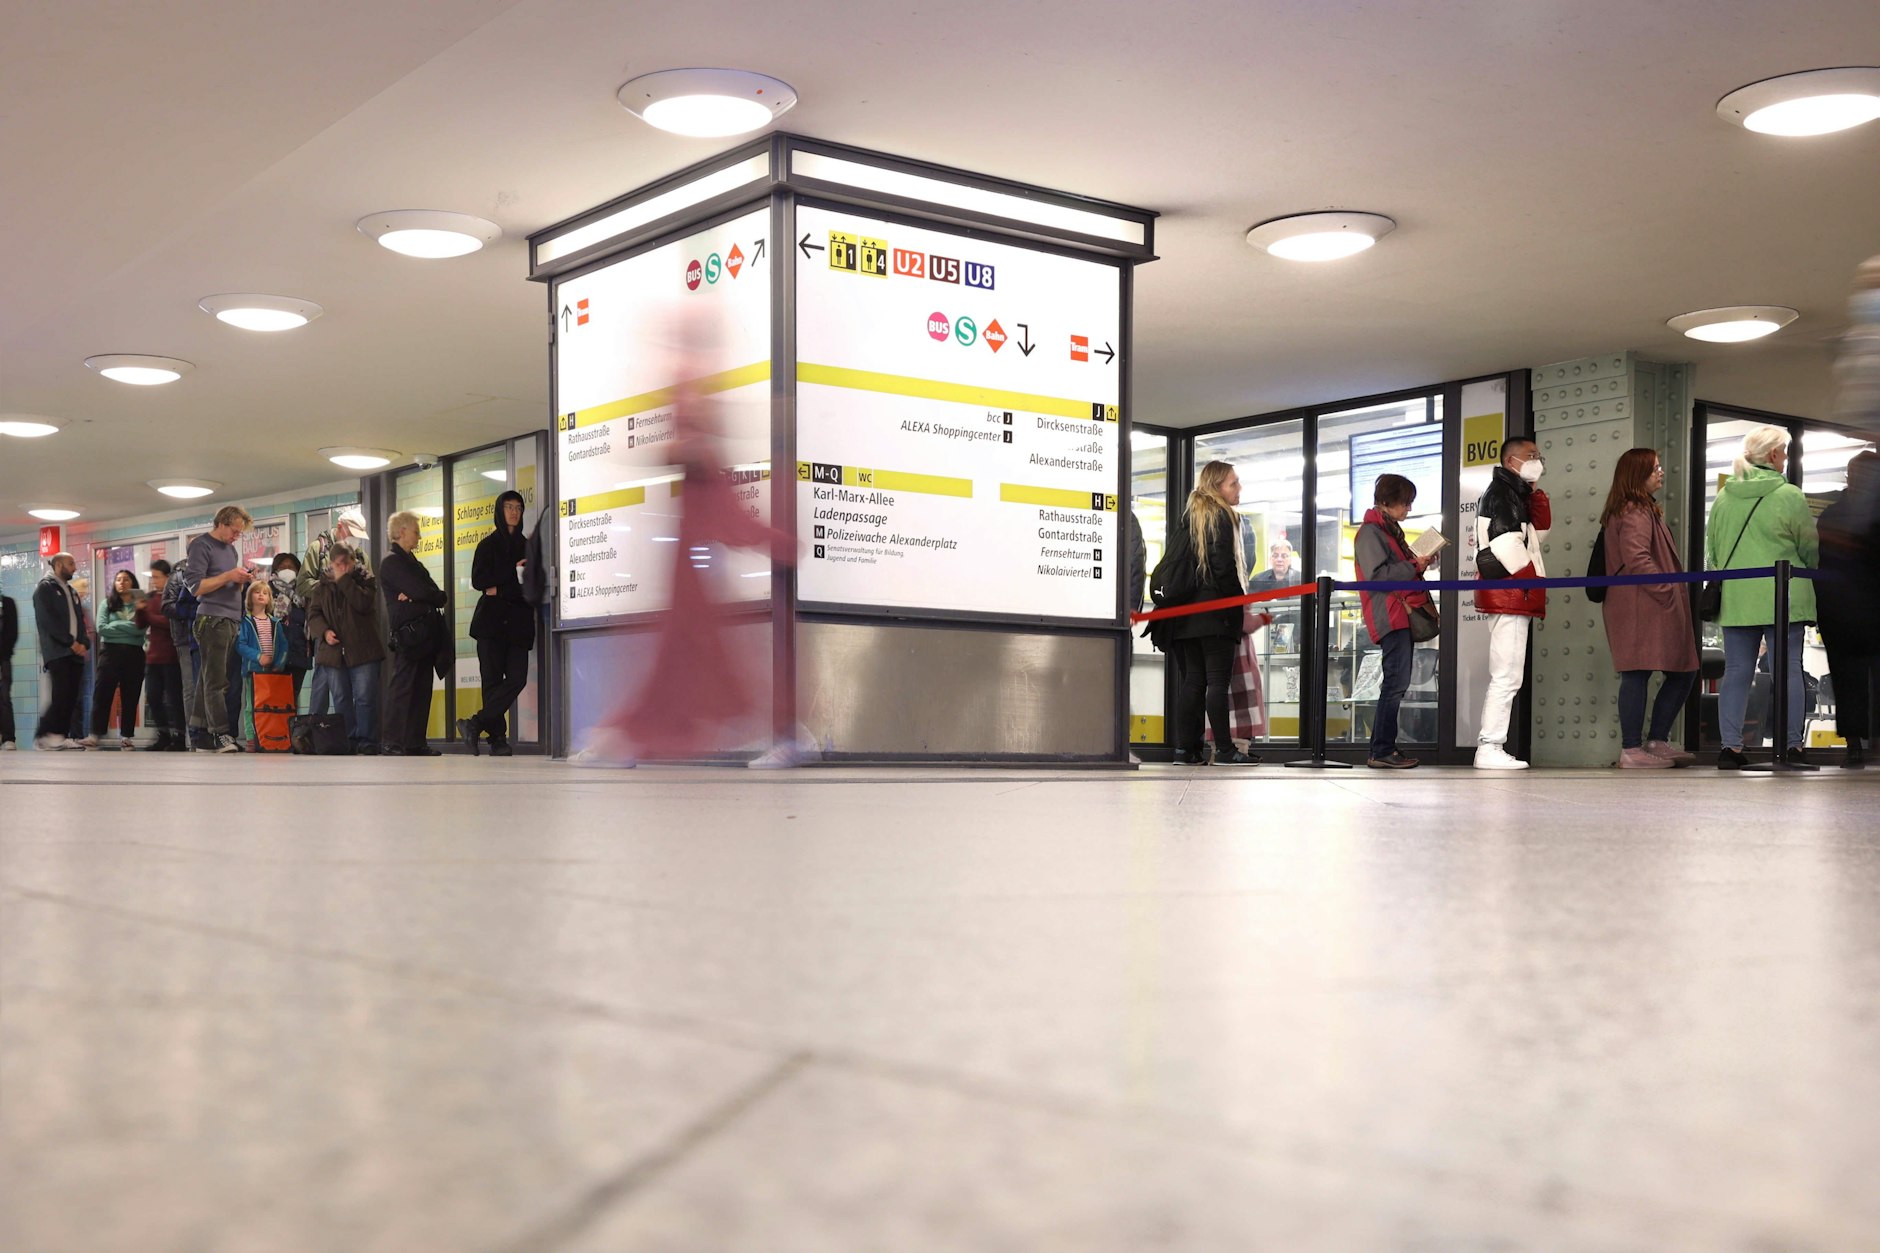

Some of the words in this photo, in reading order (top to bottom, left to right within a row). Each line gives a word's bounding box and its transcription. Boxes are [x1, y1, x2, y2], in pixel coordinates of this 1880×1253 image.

[687, 267, 701, 284] BUS
[707, 253, 720, 283] S
[847, 249, 854, 265] 1
[877, 255, 886, 270] 4
[896, 251, 923, 275] U2
[932, 257, 959, 281] U5
[967, 263, 993, 288] U8
[928, 320, 949, 335] BUS
[957, 317, 975, 345] S
[985, 329, 1005, 342] Bahn
[1070, 341, 1089, 353] Tram
[635, 411, 673, 429] Fernsehturm
[986, 410, 1002, 424] bcc
[568, 424, 610, 445] Rathausstraße
[900, 419, 931, 434] ALEXA
[932, 423, 1002, 442] Shoppingcenter
[1036, 417, 1104, 437] Dircksenstraße
[635, 429, 675, 447] Nikolaiviertel
[568, 442, 611, 462] Gontardstraße
[1467, 440, 1498, 462] BVG
[1029, 453, 1104, 473] Alexanderstraße
[814, 465, 838, 483] M-Q
[858, 472, 872, 483] WC
[813, 486, 895, 507] Karl-Marx-Allee
[457, 506, 484, 521] Schlange
[568, 512, 612, 531] Dircksenstraße
[813, 506, 888, 528] Ladenpassage
[1039, 509, 1103, 526] Rathausstraße
[457, 530, 479, 546] einfach
[568, 531, 608, 548] Grunerstraße
[826, 528, 887, 544] Polizeiwache
[889, 534, 958, 551] Alexanderplatz
[1038, 527, 1103, 544] Gontardstraße
[569, 547, 618, 565] Alexanderstraße
[826, 555, 846, 564] Jugend
[858, 557, 877, 565] Familie
[1041, 546, 1092, 560] Fernsehturm
[576, 570, 586, 581] bcc
[1037, 564, 1092, 578] Nikolaiviertel
[576, 587, 594, 598] ALEXA
[595, 582, 639, 598] Shoppingcenter
